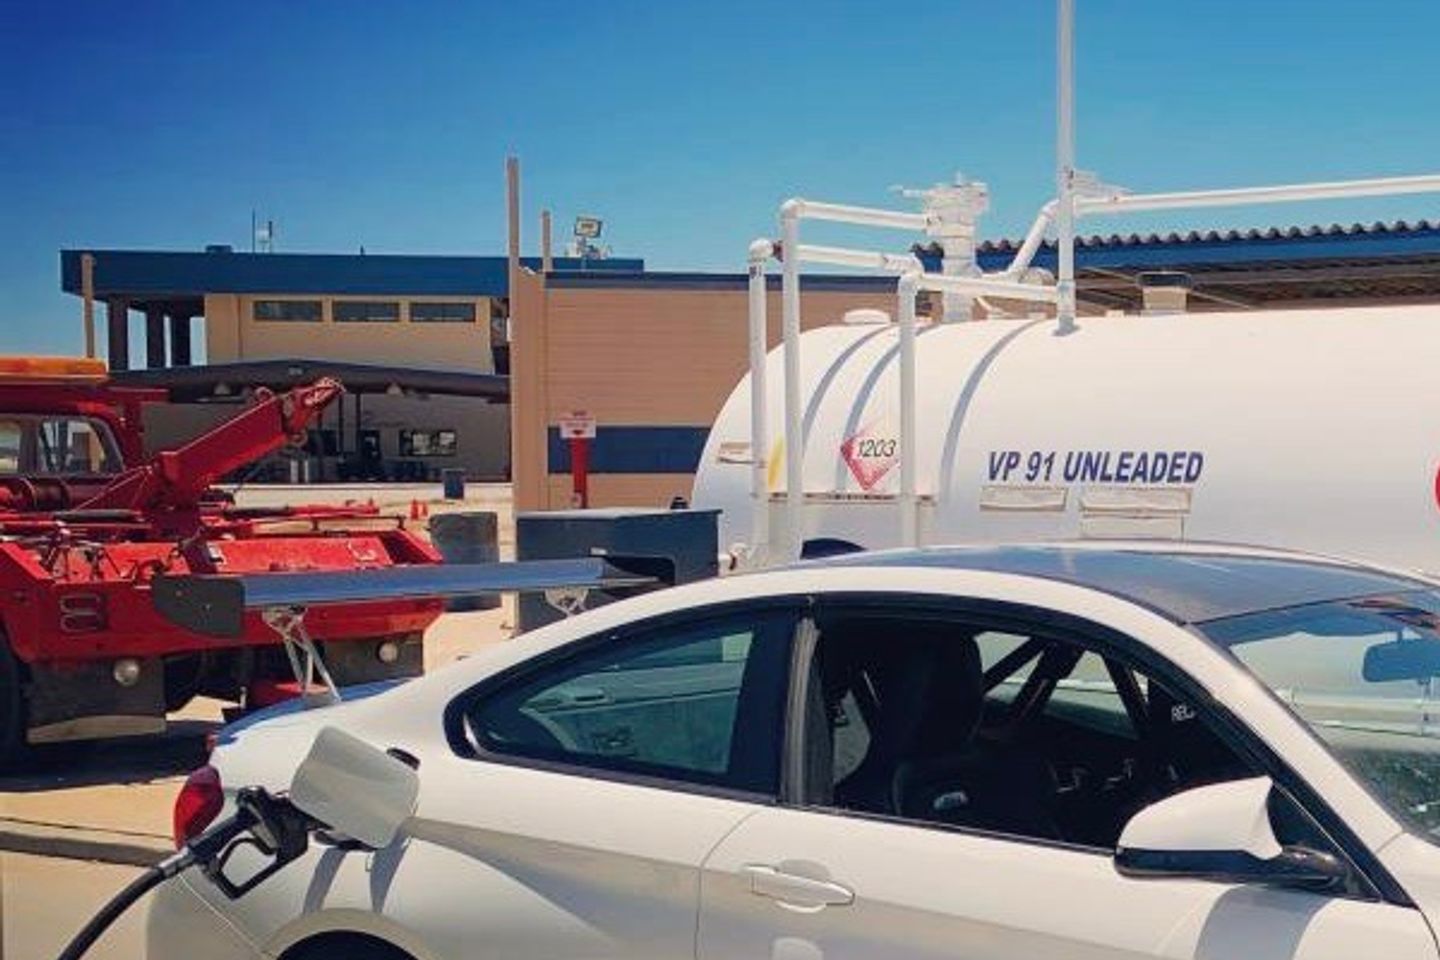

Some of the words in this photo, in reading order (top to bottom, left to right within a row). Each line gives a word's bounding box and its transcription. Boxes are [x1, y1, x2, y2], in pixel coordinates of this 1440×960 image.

[857, 439, 897, 457] 1203
[988, 451, 1021, 481] VP
[1025, 451, 1055, 481] 91
[1063, 451, 1204, 483] UNLEADED
